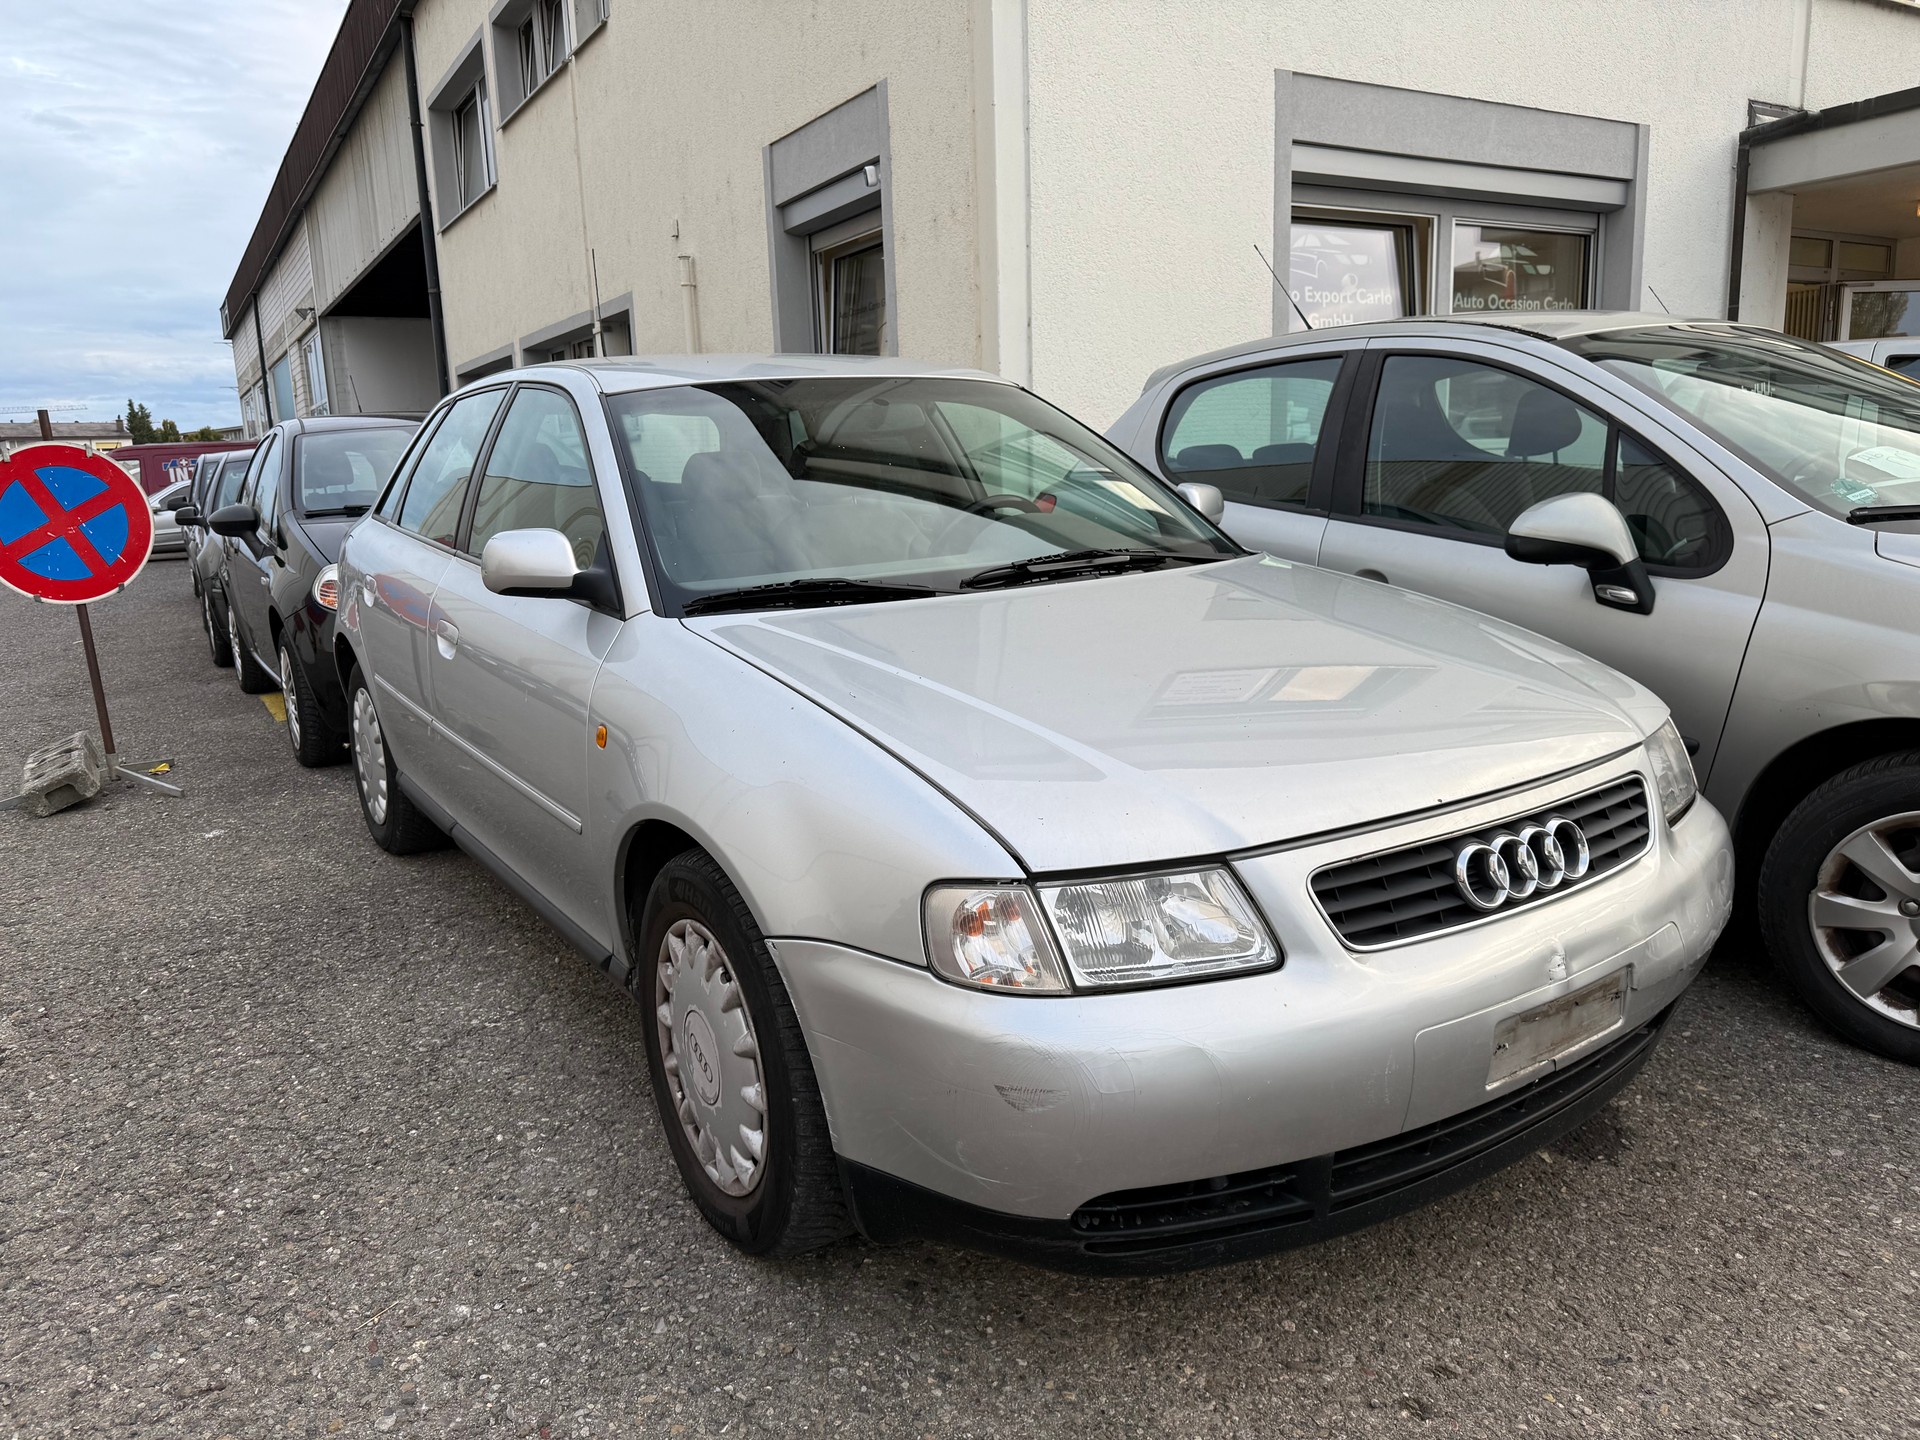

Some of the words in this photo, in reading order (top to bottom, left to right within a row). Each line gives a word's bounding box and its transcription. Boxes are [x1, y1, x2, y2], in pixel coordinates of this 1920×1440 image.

[1305, 286, 1352, 307] Export
[1356, 288, 1393, 304] Carlo
[1453, 291, 1484, 309] Auto
[1488, 293, 1540, 310] Occasion
[1544, 296, 1574, 310] Carlo
[1308, 312, 1353, 328] GmbH
